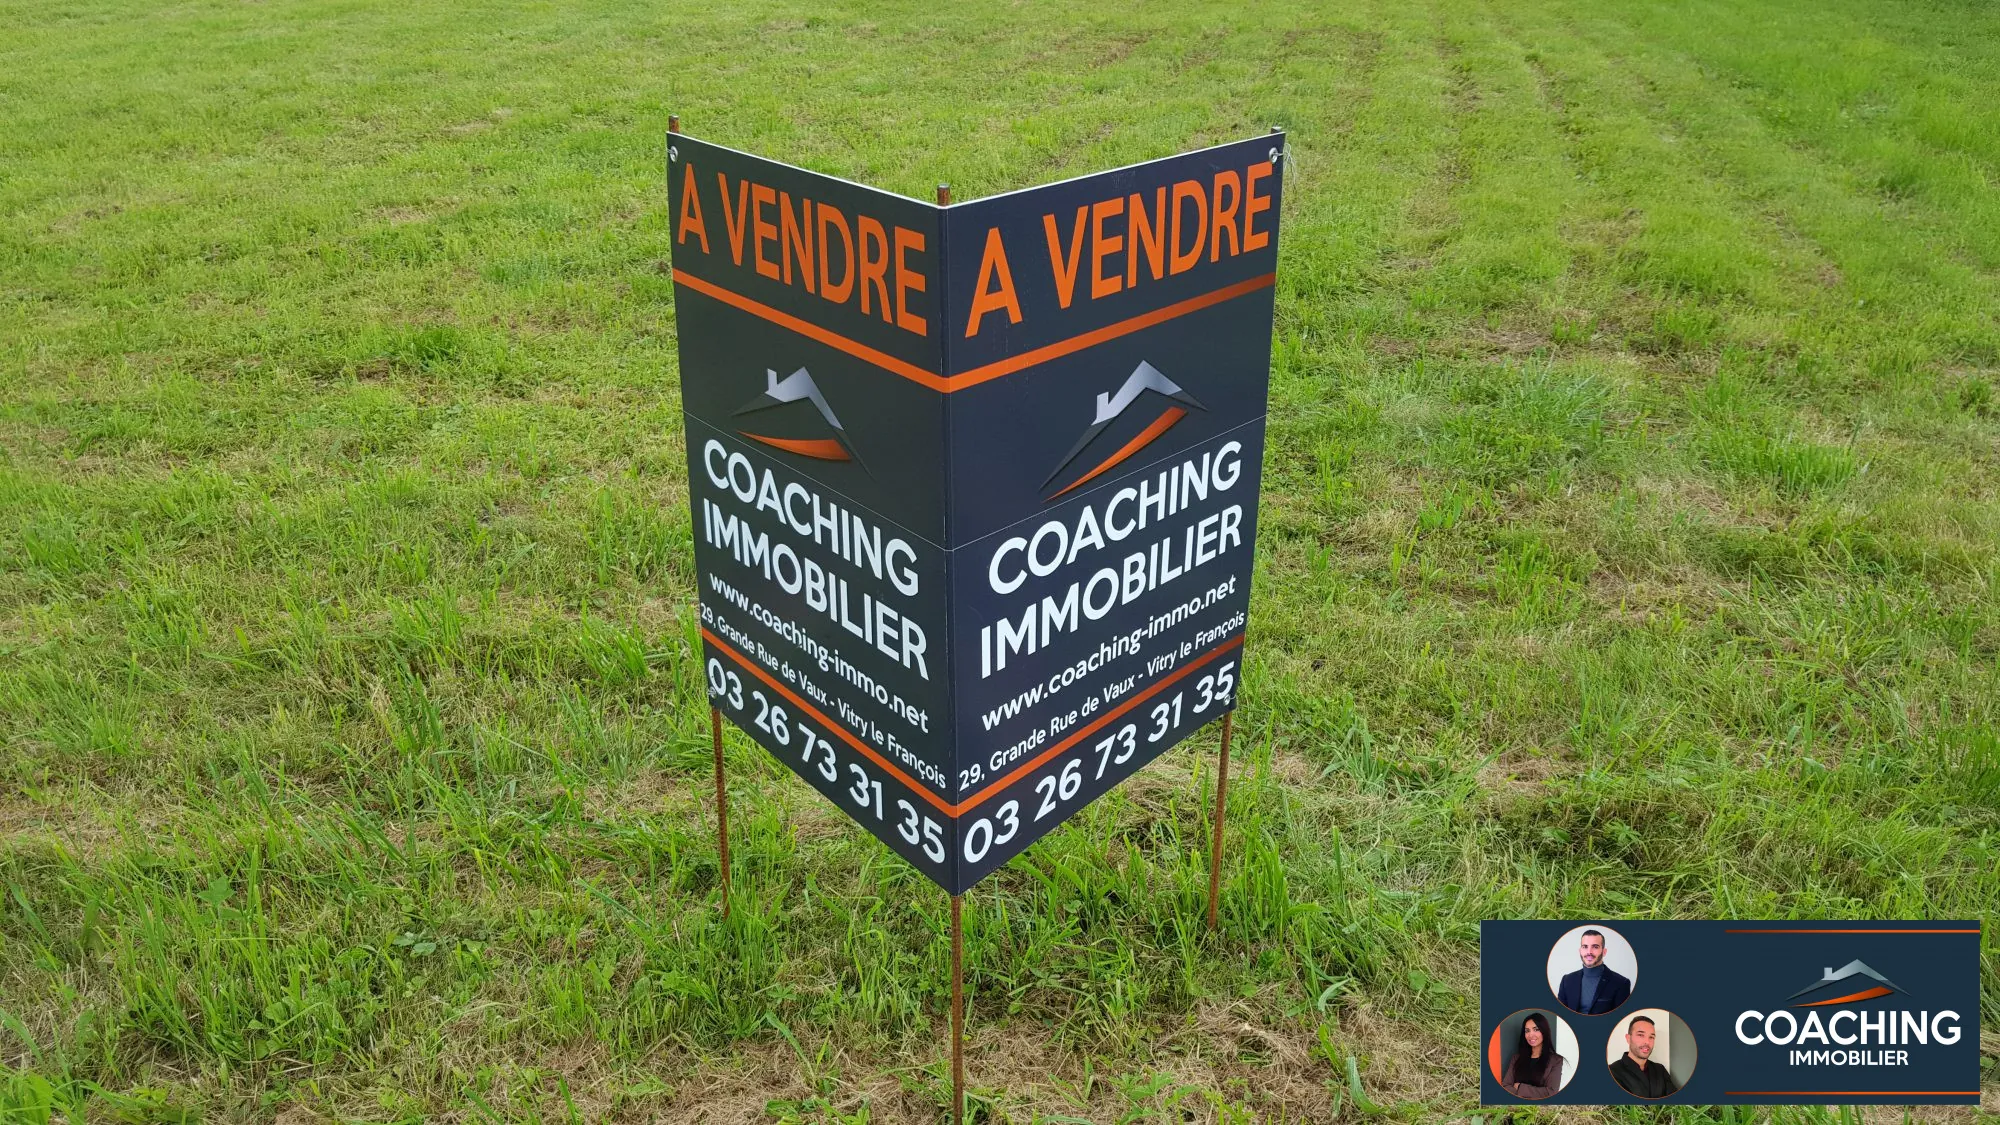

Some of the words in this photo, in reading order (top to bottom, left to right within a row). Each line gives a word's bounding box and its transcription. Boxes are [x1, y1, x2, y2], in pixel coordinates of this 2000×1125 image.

[677, 163, 710, 254] A
[717, 172, 927, 336] VENDRE
[965, 227, 1023, 338] A
[1043, 161, 1273, 309] VENDRE
[703, 498, 929, 681] IMMOBILIER
[704, 439, 919, 596] COACHING
[981, 504, 1243, 679] IMMOBILIER
[988, 440, 1242, 594] COACHING
[700, 602, 716, 628] 29,
[718, 615, 755, 655] Grande
[758, 642, 779, 671] Rue
[782, 659, 796, 684] de
[798, 671, 827, 707] Vaux
[838, 698, 868, 738] Vitry
[871, 721, 884, 746] le
[888, 733, 946, 789] François
[709, 572, 929, 734] www.coaching-immo.net
[959, 763, 985, 792] 29,
[990, 727, 1046, 772] Grande
[1050, 709, 1077, 737] Rue
[1081, 693, 1099, 718] de
[1103, 677, 1135, 703] Vaux
[1147, 649, 1177, 677] Vitry
[1180, 640, 1191, 659] le
[1195, 610, 1244, 651] François
[981, 574, 1236, 732] www.coaching-immo.net
[708, 657, 744, 711] 03
[752, 690, 790, 746] 26
[798, 722, 838, 783] 73
[849, 763, 883, 820] 31
[897, 799, 946, 864] 35
[963, 800, 1019, 864] 03
[1034, 758, 1082, 823] 26
[1095, 723, 1137, 781] 73
[1148, 692, 1183, 743] 31
[1193, 661, 1235, 714] 35
